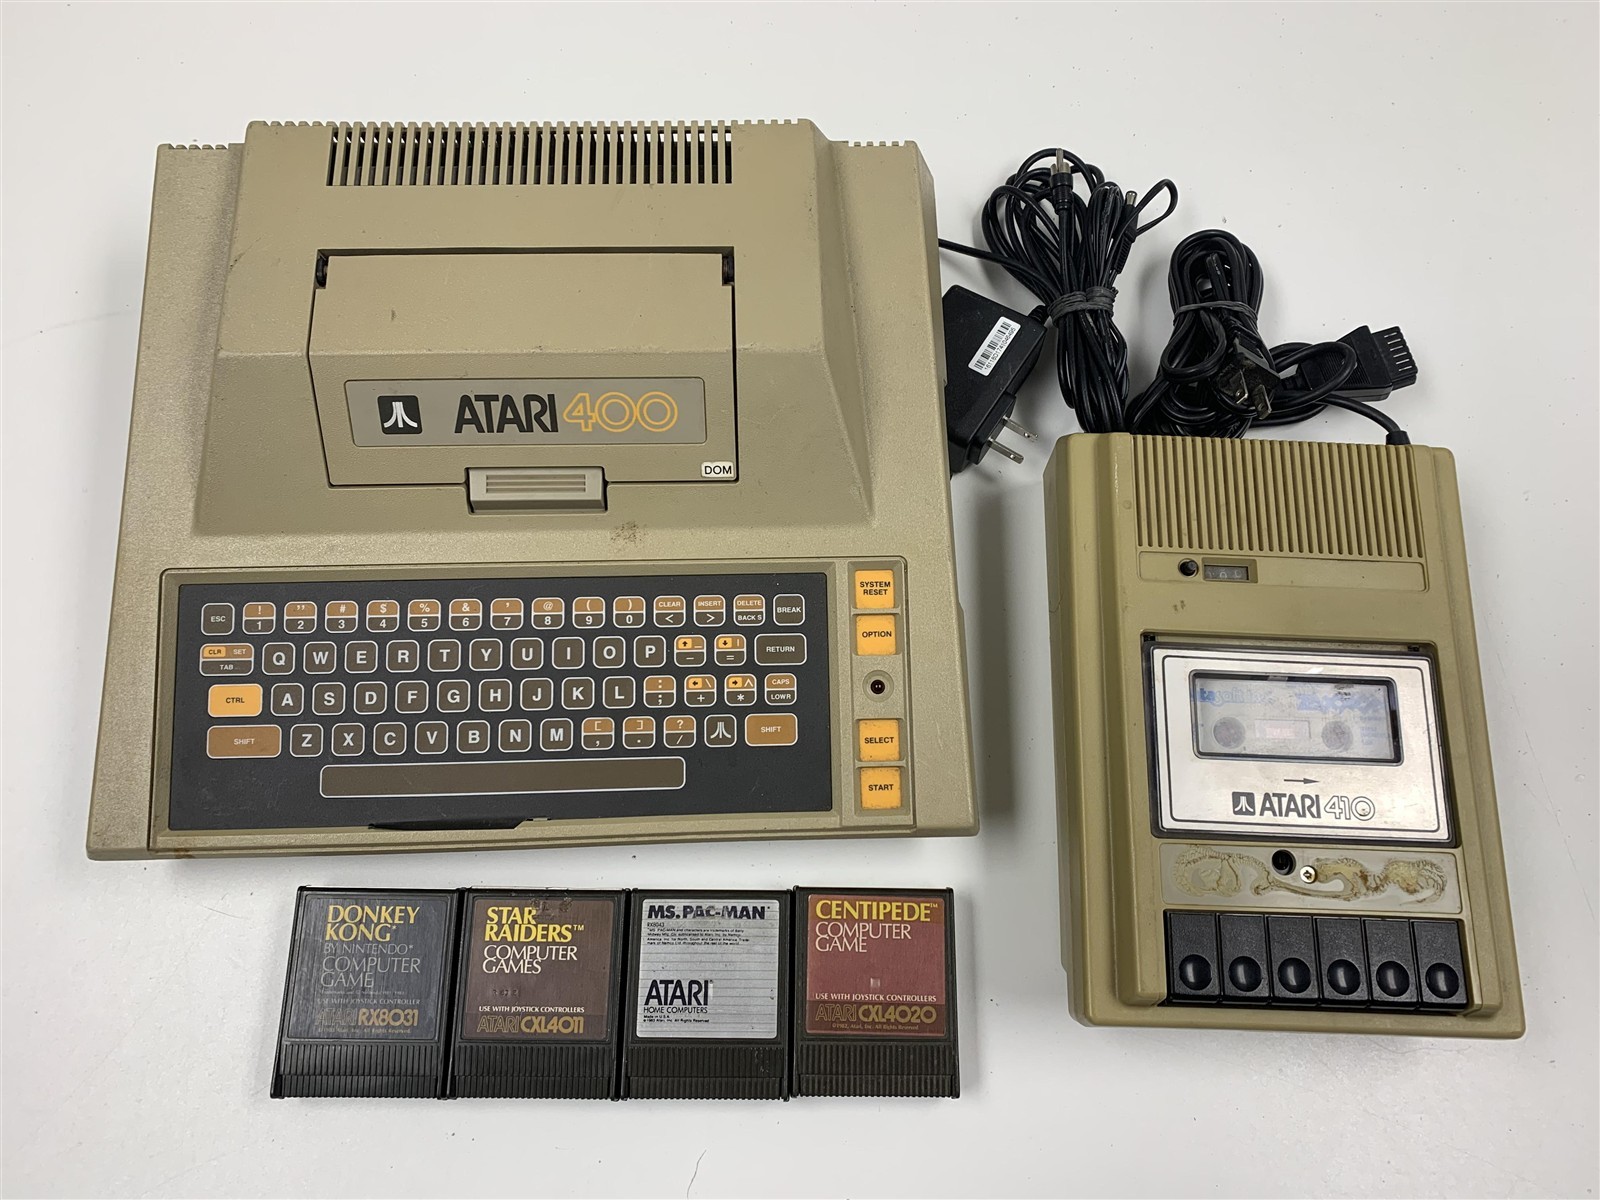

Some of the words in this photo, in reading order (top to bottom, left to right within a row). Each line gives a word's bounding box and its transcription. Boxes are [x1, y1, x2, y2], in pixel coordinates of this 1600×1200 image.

[454, 394, 559, 434] ATARI
[563, 391, 678, 432] 400
[704, 464, 732, 475] DOM
[258, 605, 261, 615] !
[340, 604, 346, 613] #
[380, 603, 387, 613] $
[419, 603, 430, 612] %
[462, 602, 470, 612] &
[543, 601, 554, 611] @
[586, 600, 591, 611] (
[628, 599, 632, 611] )
[297, 620, 304, 629] 2
[338, 619, 345, 629] 3
[379, 619, 386, 628] 4
[421, 618, 428, 628] 5
[462, 617, 469, 627] 6
[504, 617, 511, 626] 7
[544, 616, 552, 625] 8
[586, 615, 592, 625] 9
[626, 615, 633, 624] 0
[665, 614, 674, 623] <
[706, 613, 715, 623] >
[257, 621, 261, 630] 1
[862, 630, 892, 638] OPTION
[313, 651, 329, 665] W
[356, 651, 367, 664] E
[398, 650, 409, 663] R
[439, 649, 450, 662] T
[481, 648, 492, 661] Y
[522, 648, 533, 661] U
[567, 647, 571, 660] I
[603, 646, 616, 659] O
[645, 645, 656, 658] P
[273, 652, 285, 665] Q
[324, 692, 335, 706] S
[365, 691, 377, 705] D
[408, 690, 418, 704] F
[447, 689, 460, 703] G
[490, 689, 501, 702] H
[532, 688, 541, 701] J
[573, 687, 584, 700] K
[615, 686, 625, 699] L
[697, 694, 705, 702] +
[281, 693, 293, 706] A
[658, 695, 663, 705] ;
[594, 721, 601, 730] [
[636, 720, 643, 730] ]
[677, 719, 684, 729] ?
[301, 734, 312, 747] Z
[343, 733, 354, 746] X
[384, 732, 396, 746] C
[426, 731, 438, 744] V
[468, 730, 480, 743] B
[510, 729, 521, 742] N
[550, 728, 563, 741] M
[676, 735, 683, 744] /
[864, 736, 894, 744] SELECT
[1259, 792, 1321, 819] ATARI
[1323, 795, 1376, 822] 410
[327, 904, 420, 924] DONKEY
[486, 906, 537, 925] STAR
[647, 905, 681, 919] MS.
[815, 921, 912, 940] COMPUTER
[324, 943, 337, 954] BY
[815, 936, 867, 952] GAME
[483, 944, 578, 961] COMPUTER
[322, 956, 421, 974] COMPUTER
[482, 958, 542, 974] GAMES
[320, 971, 374, 988] GAME
[831, 993, 850, 1001] WITH
[852, 993, 885, 1001] JOYSTICK
[886, 994, 937, 1002] CONTROLLERS
[643, 1006, 664, 1014] HOME
[666, 1006, 708, 1014] COMPUTERS
[815, 1004, 857, 1022] ATARI
[858, 1004, 937, 1024] CXL4020
[358, 1008, 419, 1027] RX8031
[477, 1015, 521, 1033] ATARI
[520, 1015, 584, 1034] CXL4011
